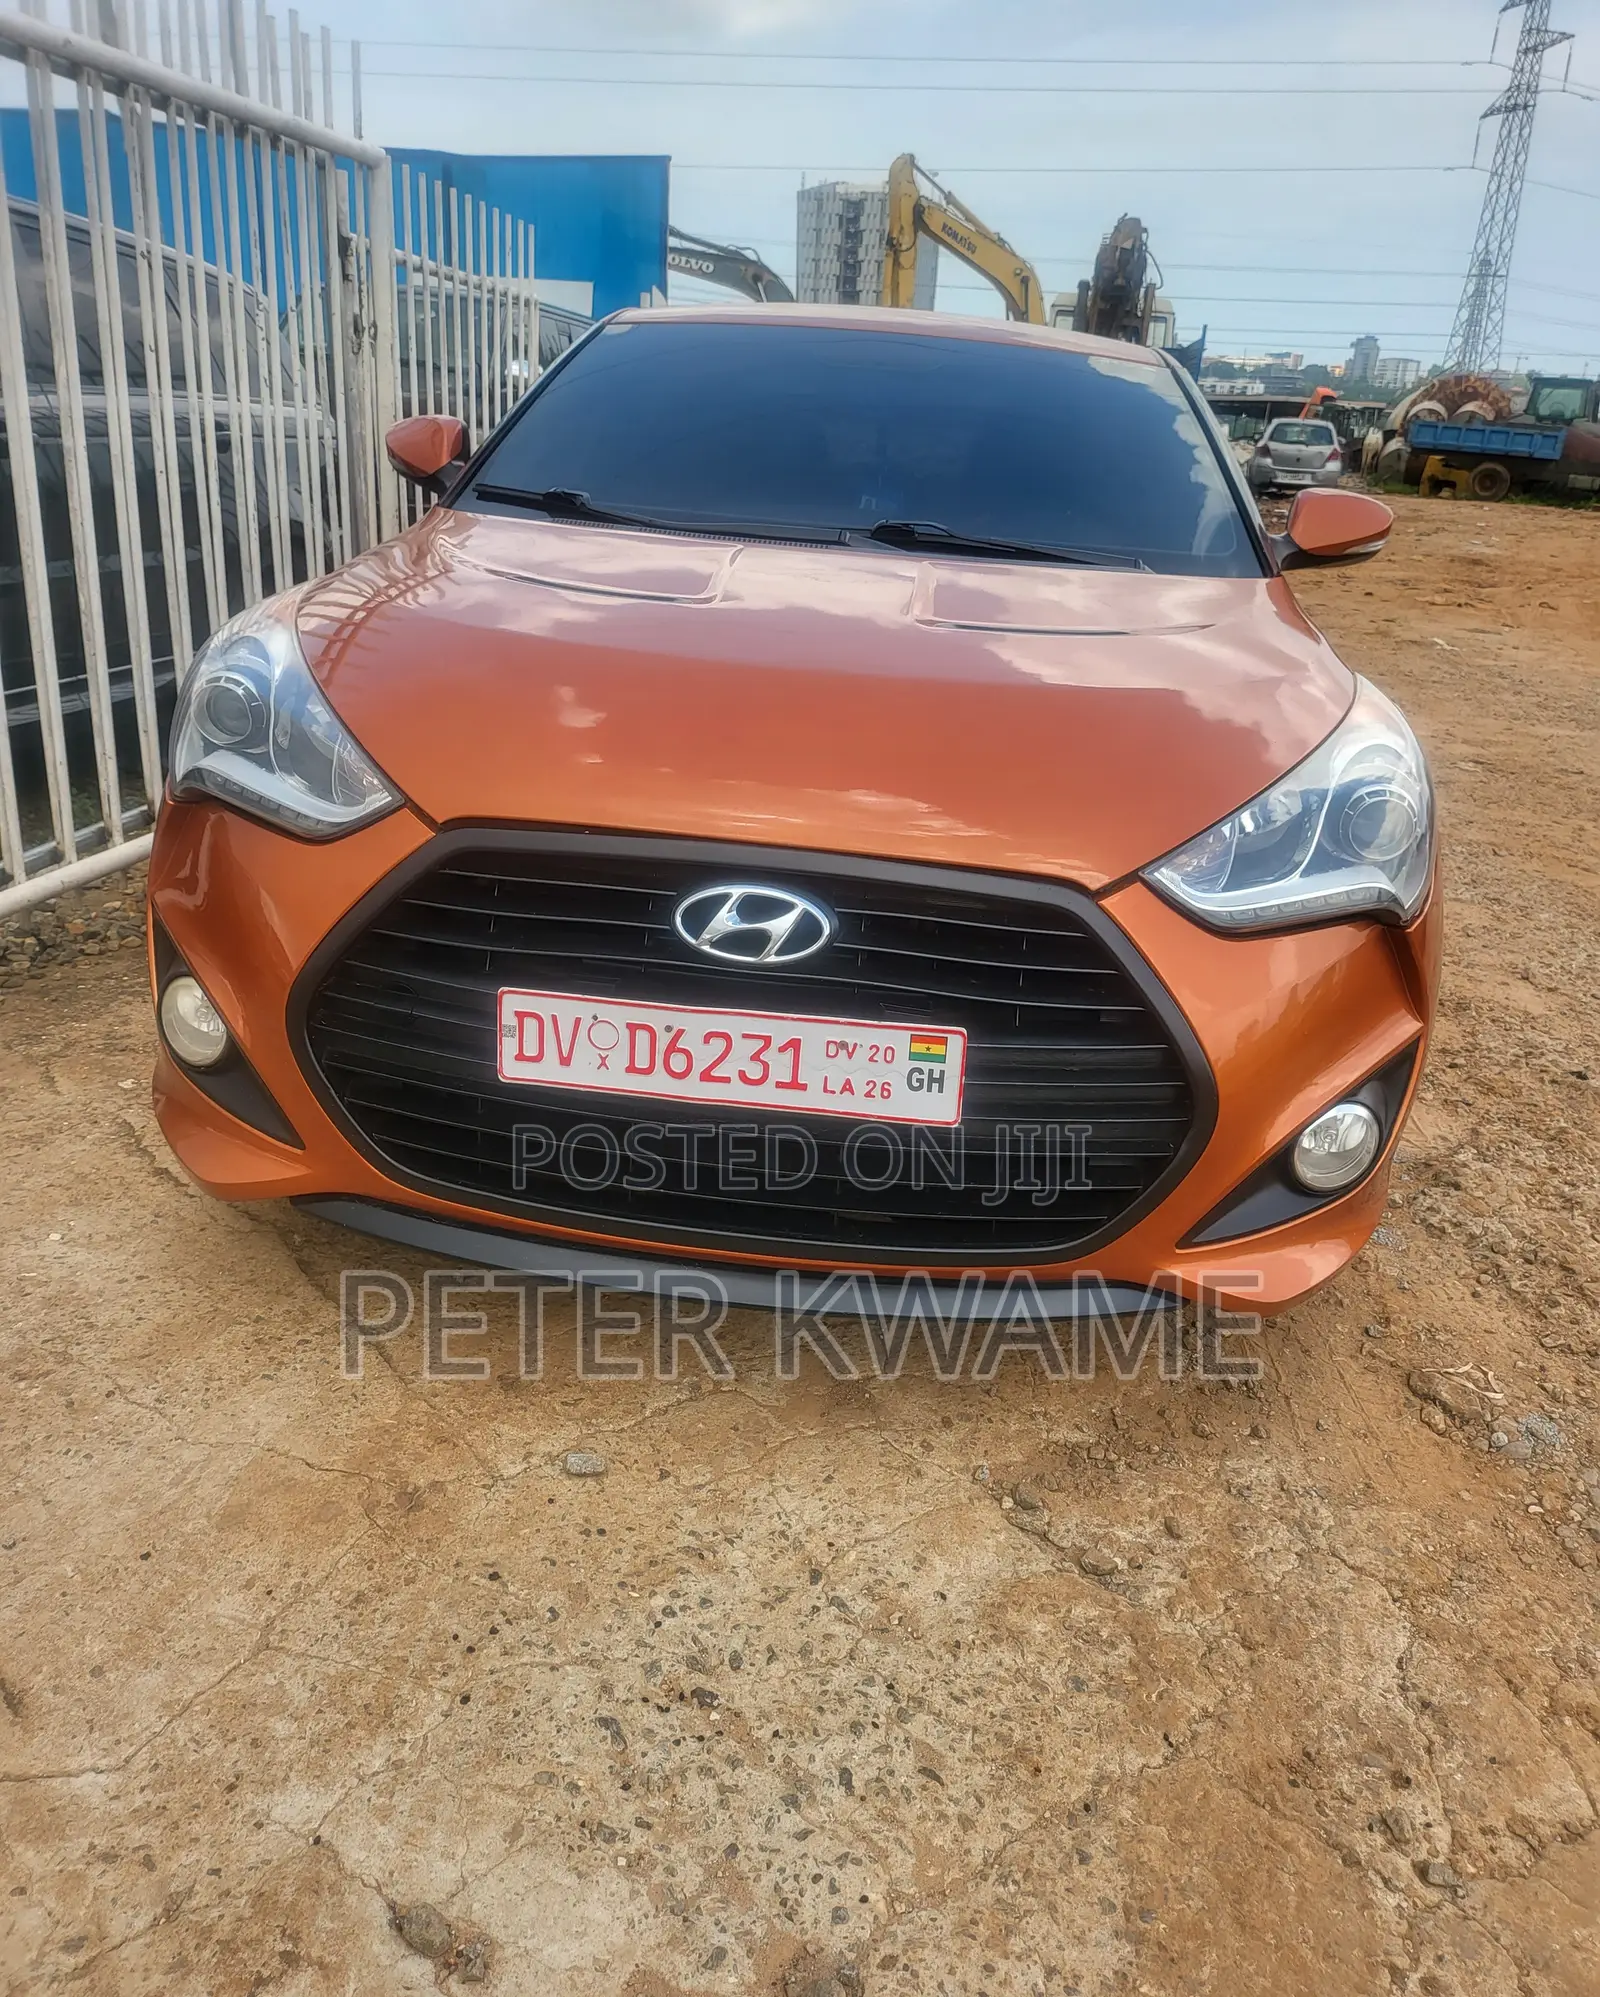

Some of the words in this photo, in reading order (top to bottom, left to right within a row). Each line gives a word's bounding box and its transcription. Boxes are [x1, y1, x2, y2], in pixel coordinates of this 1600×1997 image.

[941, 221, 977, 255] KOMATSU
[668, 253, 715, 274] OLVO
[513, 1010, 582, 1067] DV
[624, 1021, 808, 1092] D6231
[867, 1043, 896, 1064] 20
[822, 1075, 855, 1096] LA
[863, 1079, 892, 1100] 26
[906, 1066, 946, 1094] GH
